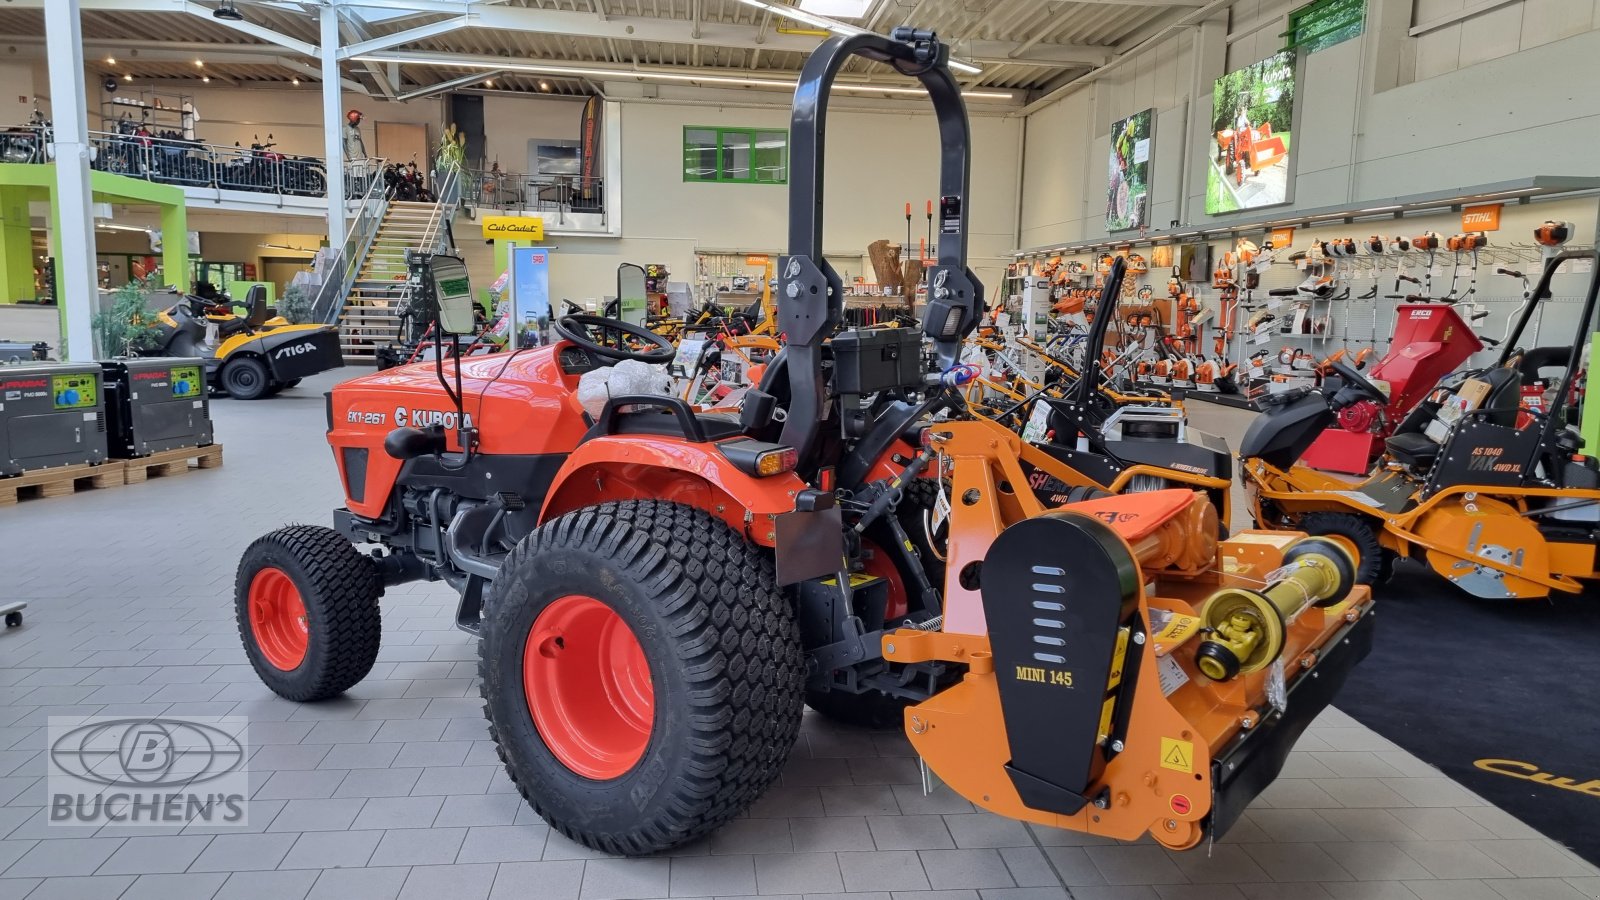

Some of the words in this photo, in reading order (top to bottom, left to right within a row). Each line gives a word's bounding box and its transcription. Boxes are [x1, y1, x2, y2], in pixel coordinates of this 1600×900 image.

[1262, 65, 1292, 84] Kubota
[1464, 212, 1491, 224] STIHL
[487, 223, 506, 231] Cub
[507, 224, 538, 233] Cadet
[1272, 234, 1289, 242] STIHL
[275, 342, 317, 360] STIGA
[347, 411, 386, 425] EK1-261
[1472, 447, 1482, 455] AS
[1483, 447, 1503, 455] 1040
[1467, 456, 1499, 471] YAK
[1492, 463, 1511, 472] 4WD
[1511, 464, 1522, 473] XL
[1050, 494, 1068, 503] 4WD
[1016, 666, 1046, 682] MINI
[1050, 670, 1073, 686] 145
